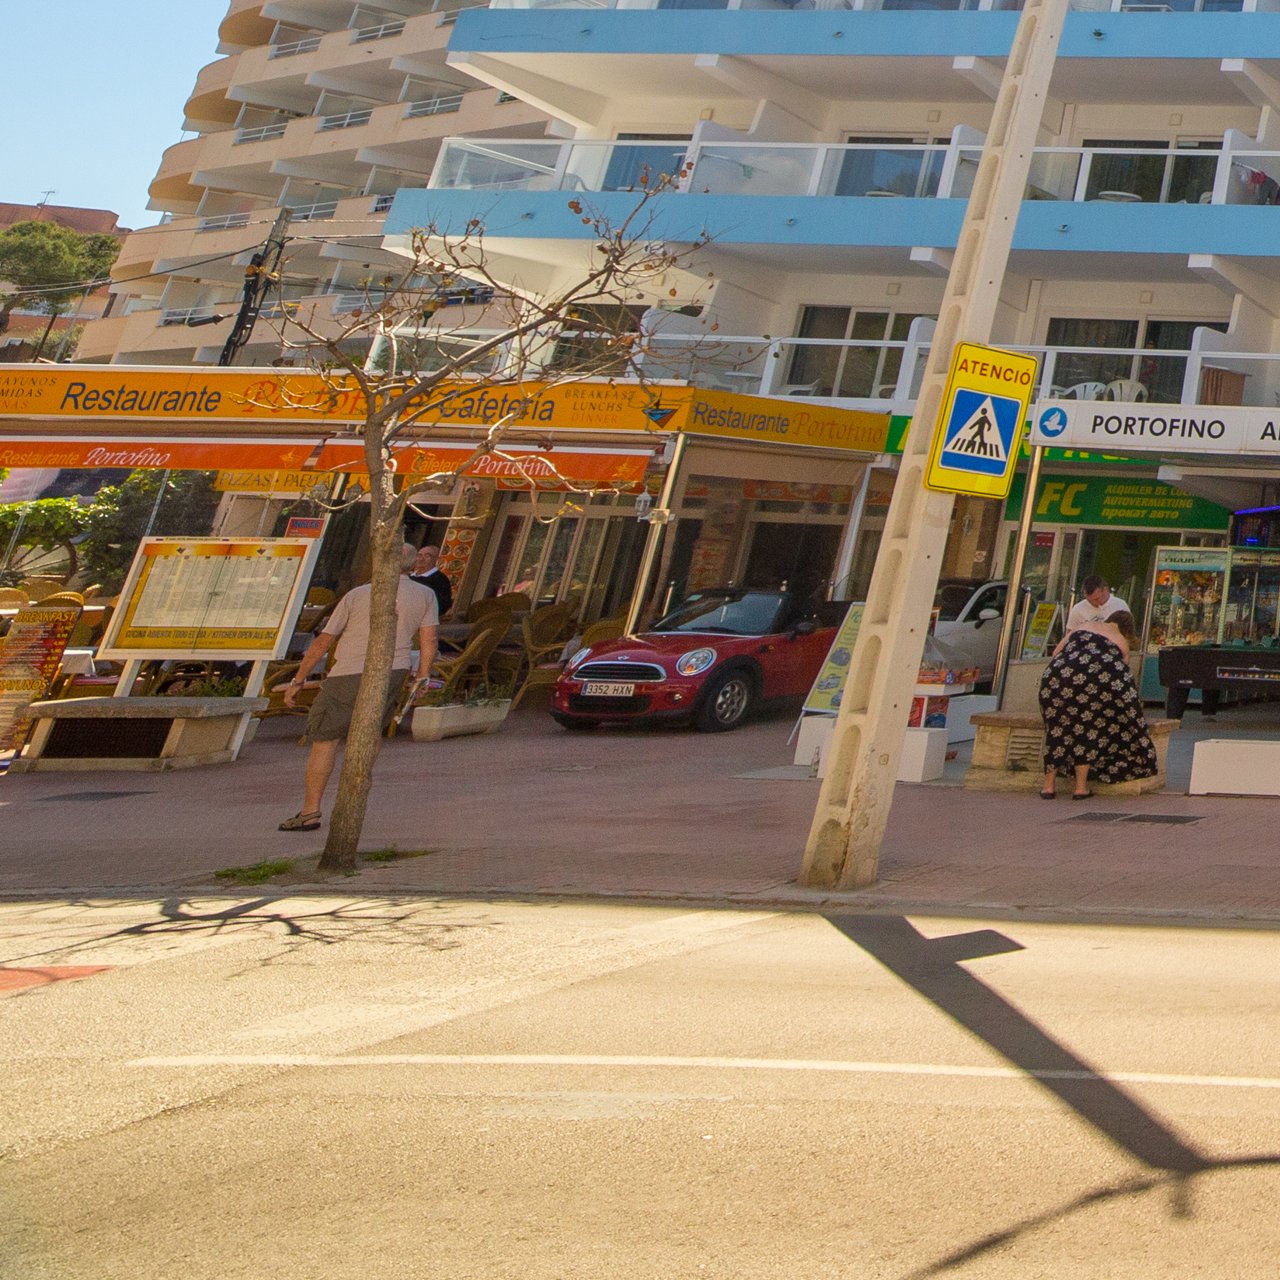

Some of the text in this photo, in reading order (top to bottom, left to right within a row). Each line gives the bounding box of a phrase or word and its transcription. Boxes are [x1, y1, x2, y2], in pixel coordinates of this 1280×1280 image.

[958, 358, 1031, 386] ATENCIÓ
[0, 376, 57, 386] AYUNOS
[0, 388, 43, 398] MIDAS
[60, 382, 221, 412] Restaurante
[572, 401, 623, 412] LUNCHS
[693, 401, 790, 434] Restaurante
[792, 411, 885, 444] Portofino
[1091, 415, 1226, 439] PORTOFINO
[1, 447, 171, 467] Restaurante Portofino
[1037, 482, 1087, 516] FC
[1103, 496, 1193, 509] AUTOVERMIETUNG
[17, 611, 76, 622] BREAKFAST
[588, 684, 632, 695] 3352 HXN
